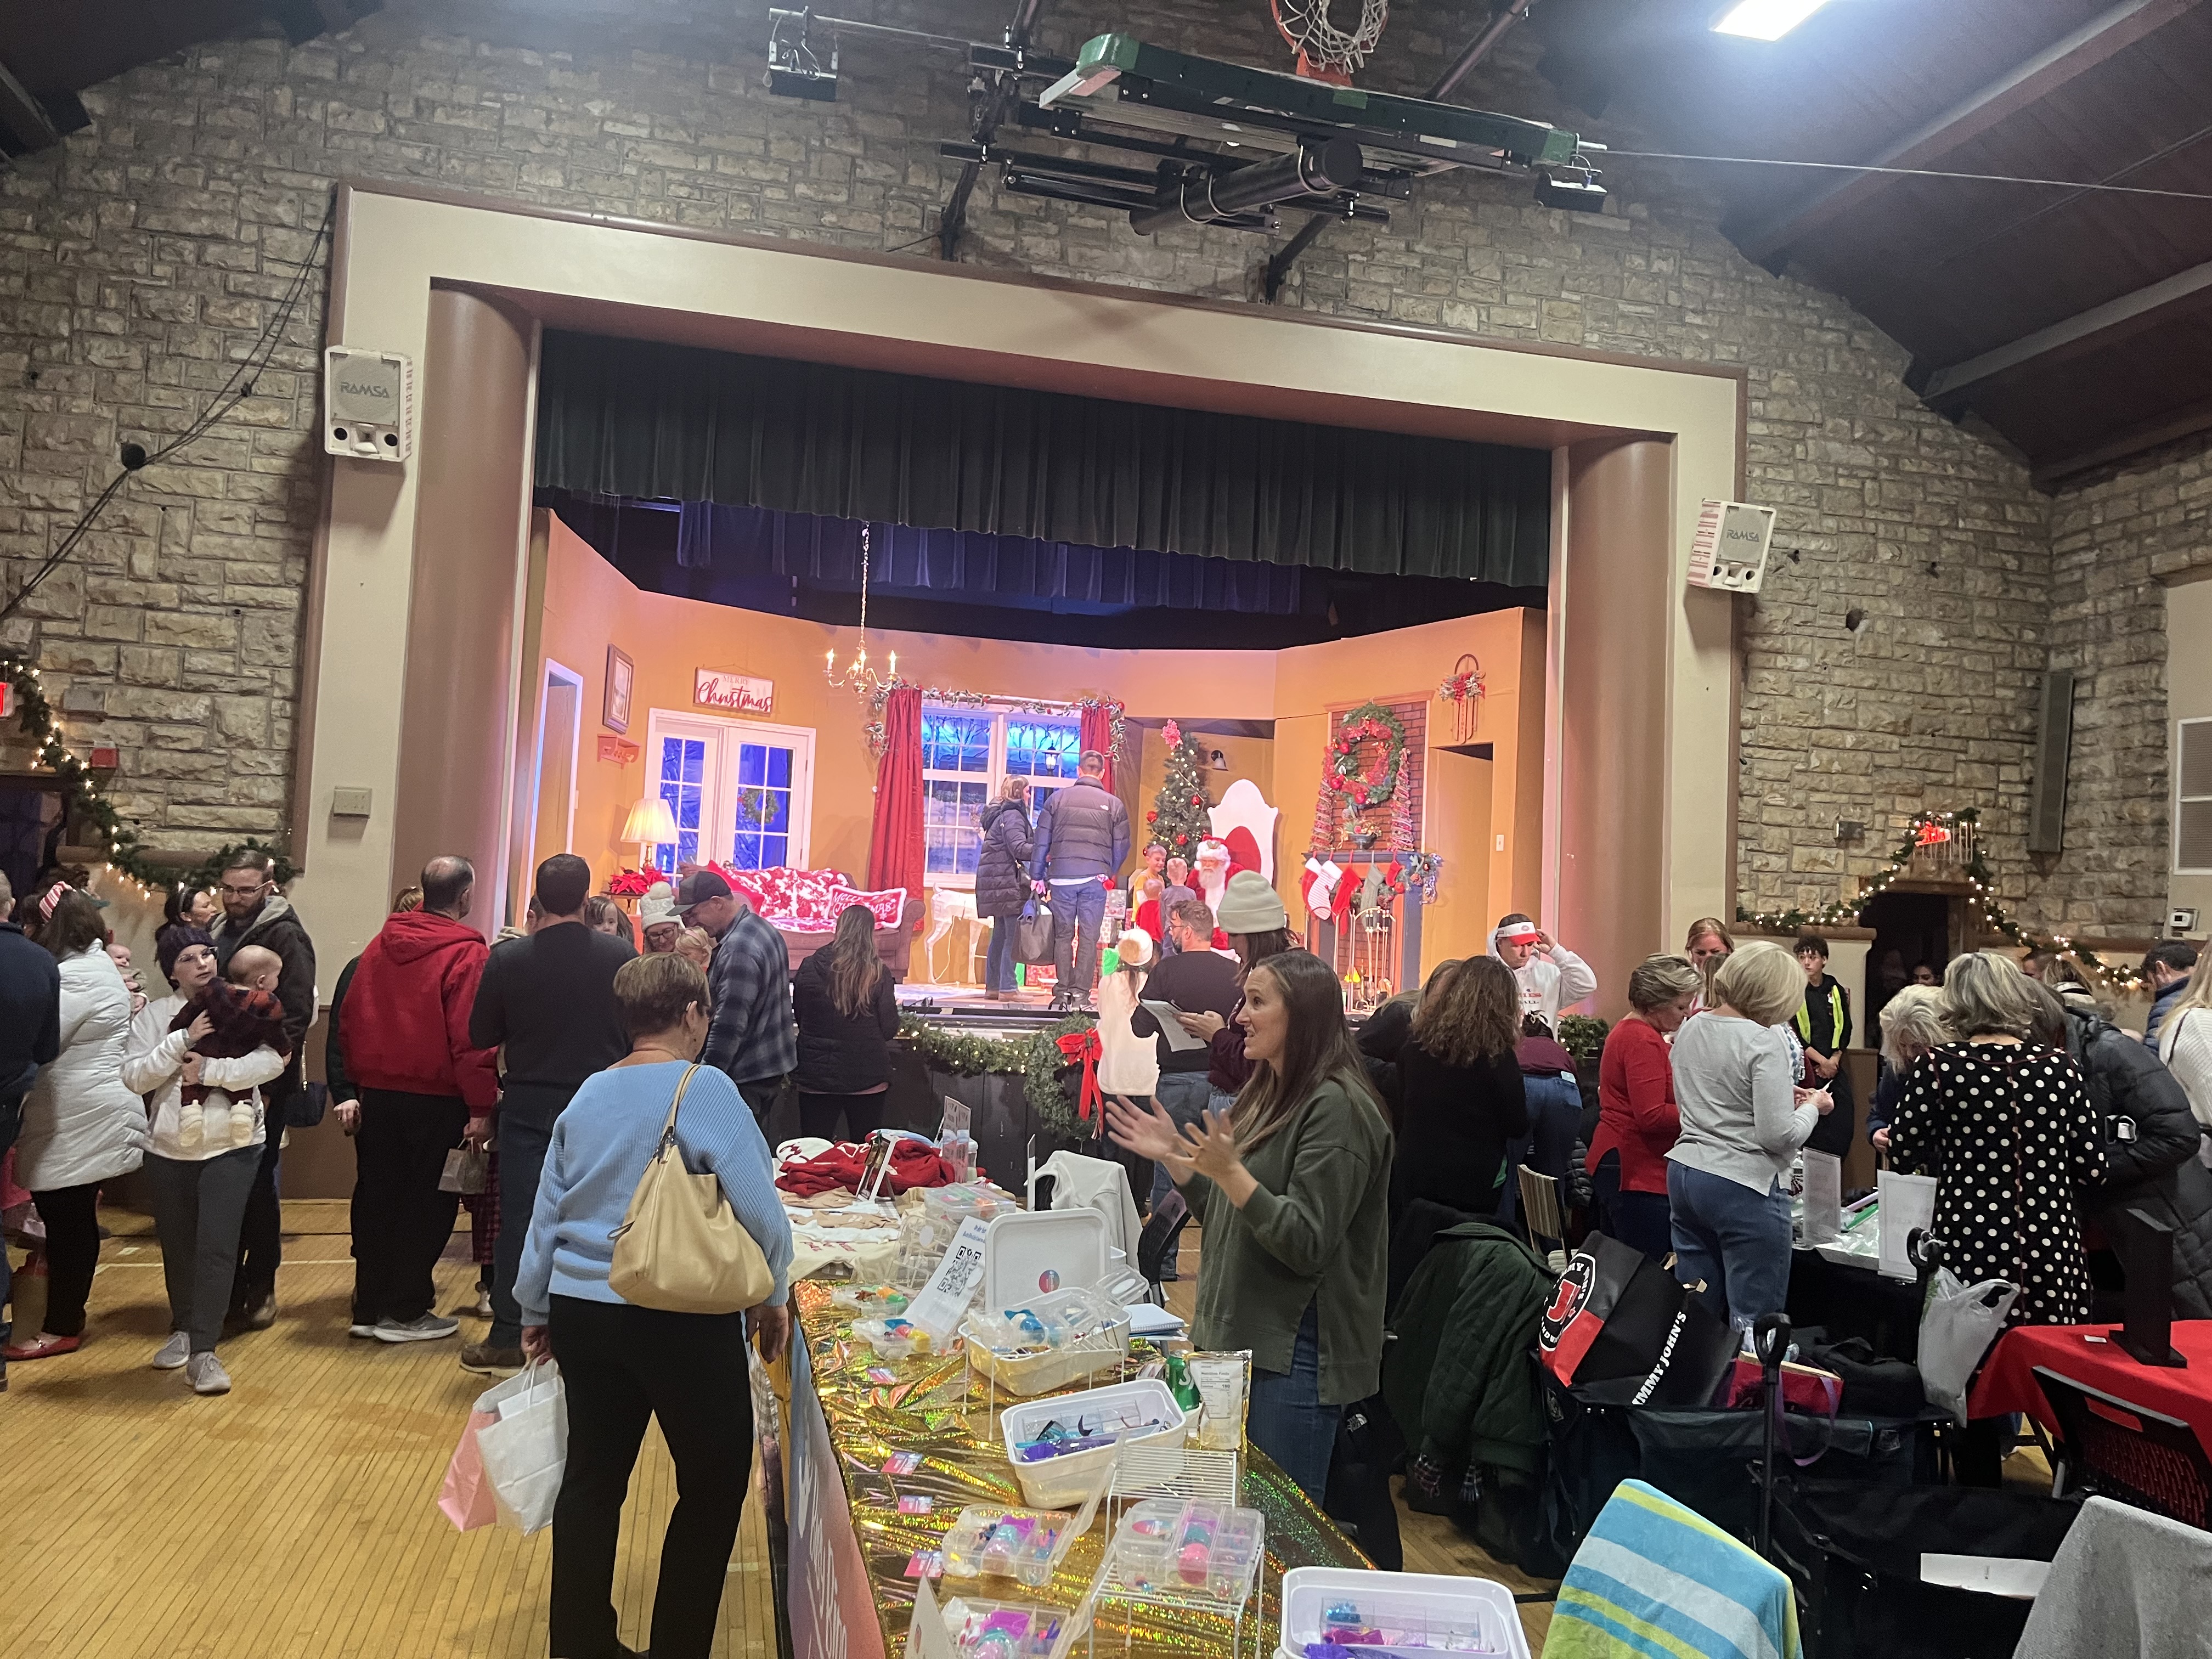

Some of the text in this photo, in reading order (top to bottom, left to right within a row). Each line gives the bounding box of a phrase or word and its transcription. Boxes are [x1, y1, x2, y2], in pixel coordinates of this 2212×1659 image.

[340, 382, 390, 398] RAMSA
[1726, 530, 1759, 542] RAMSA
[723, 675, 750, 685] MERRY
[697, 678, 772, 712] Christmas
[1632, 1311, 1686, 1405] IMMY JOHN'S
